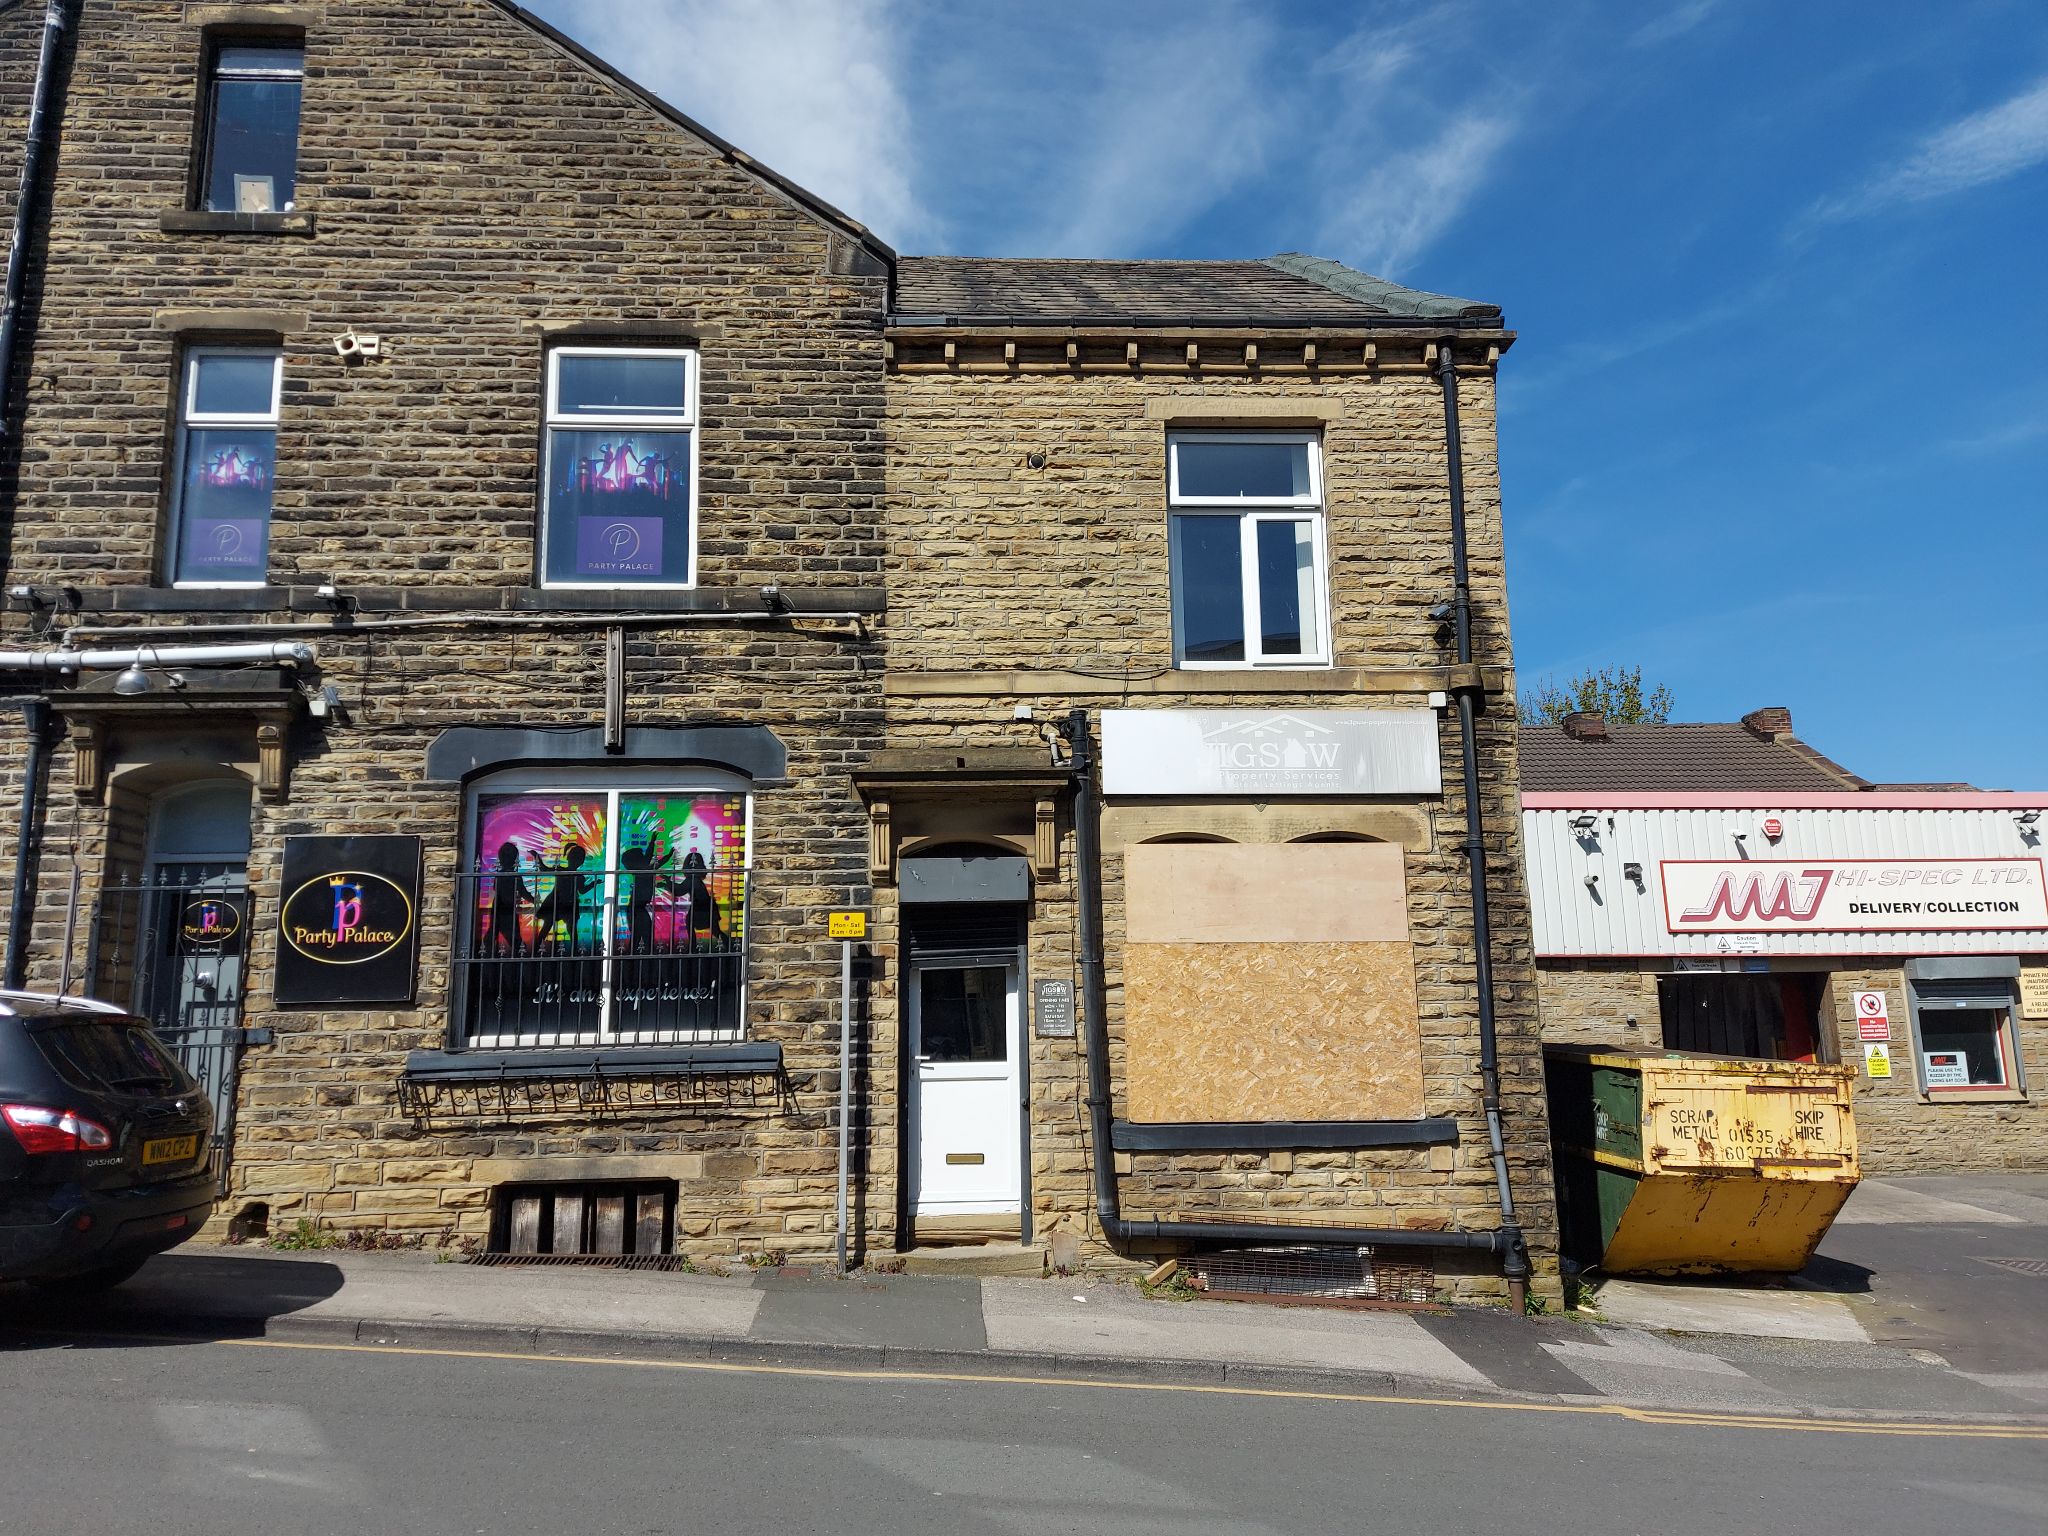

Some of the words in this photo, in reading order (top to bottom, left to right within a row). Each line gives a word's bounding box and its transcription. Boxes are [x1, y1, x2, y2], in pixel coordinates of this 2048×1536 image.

[1218, 771, 1277, 782] Property
[1284, 771, 1340, 780] Services
[1849, 901, 2020, 914] DELIVERY/COLLECTION
[185, 925, 204, 935] Pary
[296, 928, 336, 949] Party
[344, 926, 392, 943] Palace
[569, 990, 597, 1003] an
[615, 979, 716, 1010] experience!
[1670, 1109, 1714, 1124] SCRAP
[1795, 1110, 1824, 1124] SKIP
[1672, 1125, 1717, 1140] METAL
[1729, 1128, 1774, 1143] 01535
[1795, 1126, 1824, 1140] HIRE
